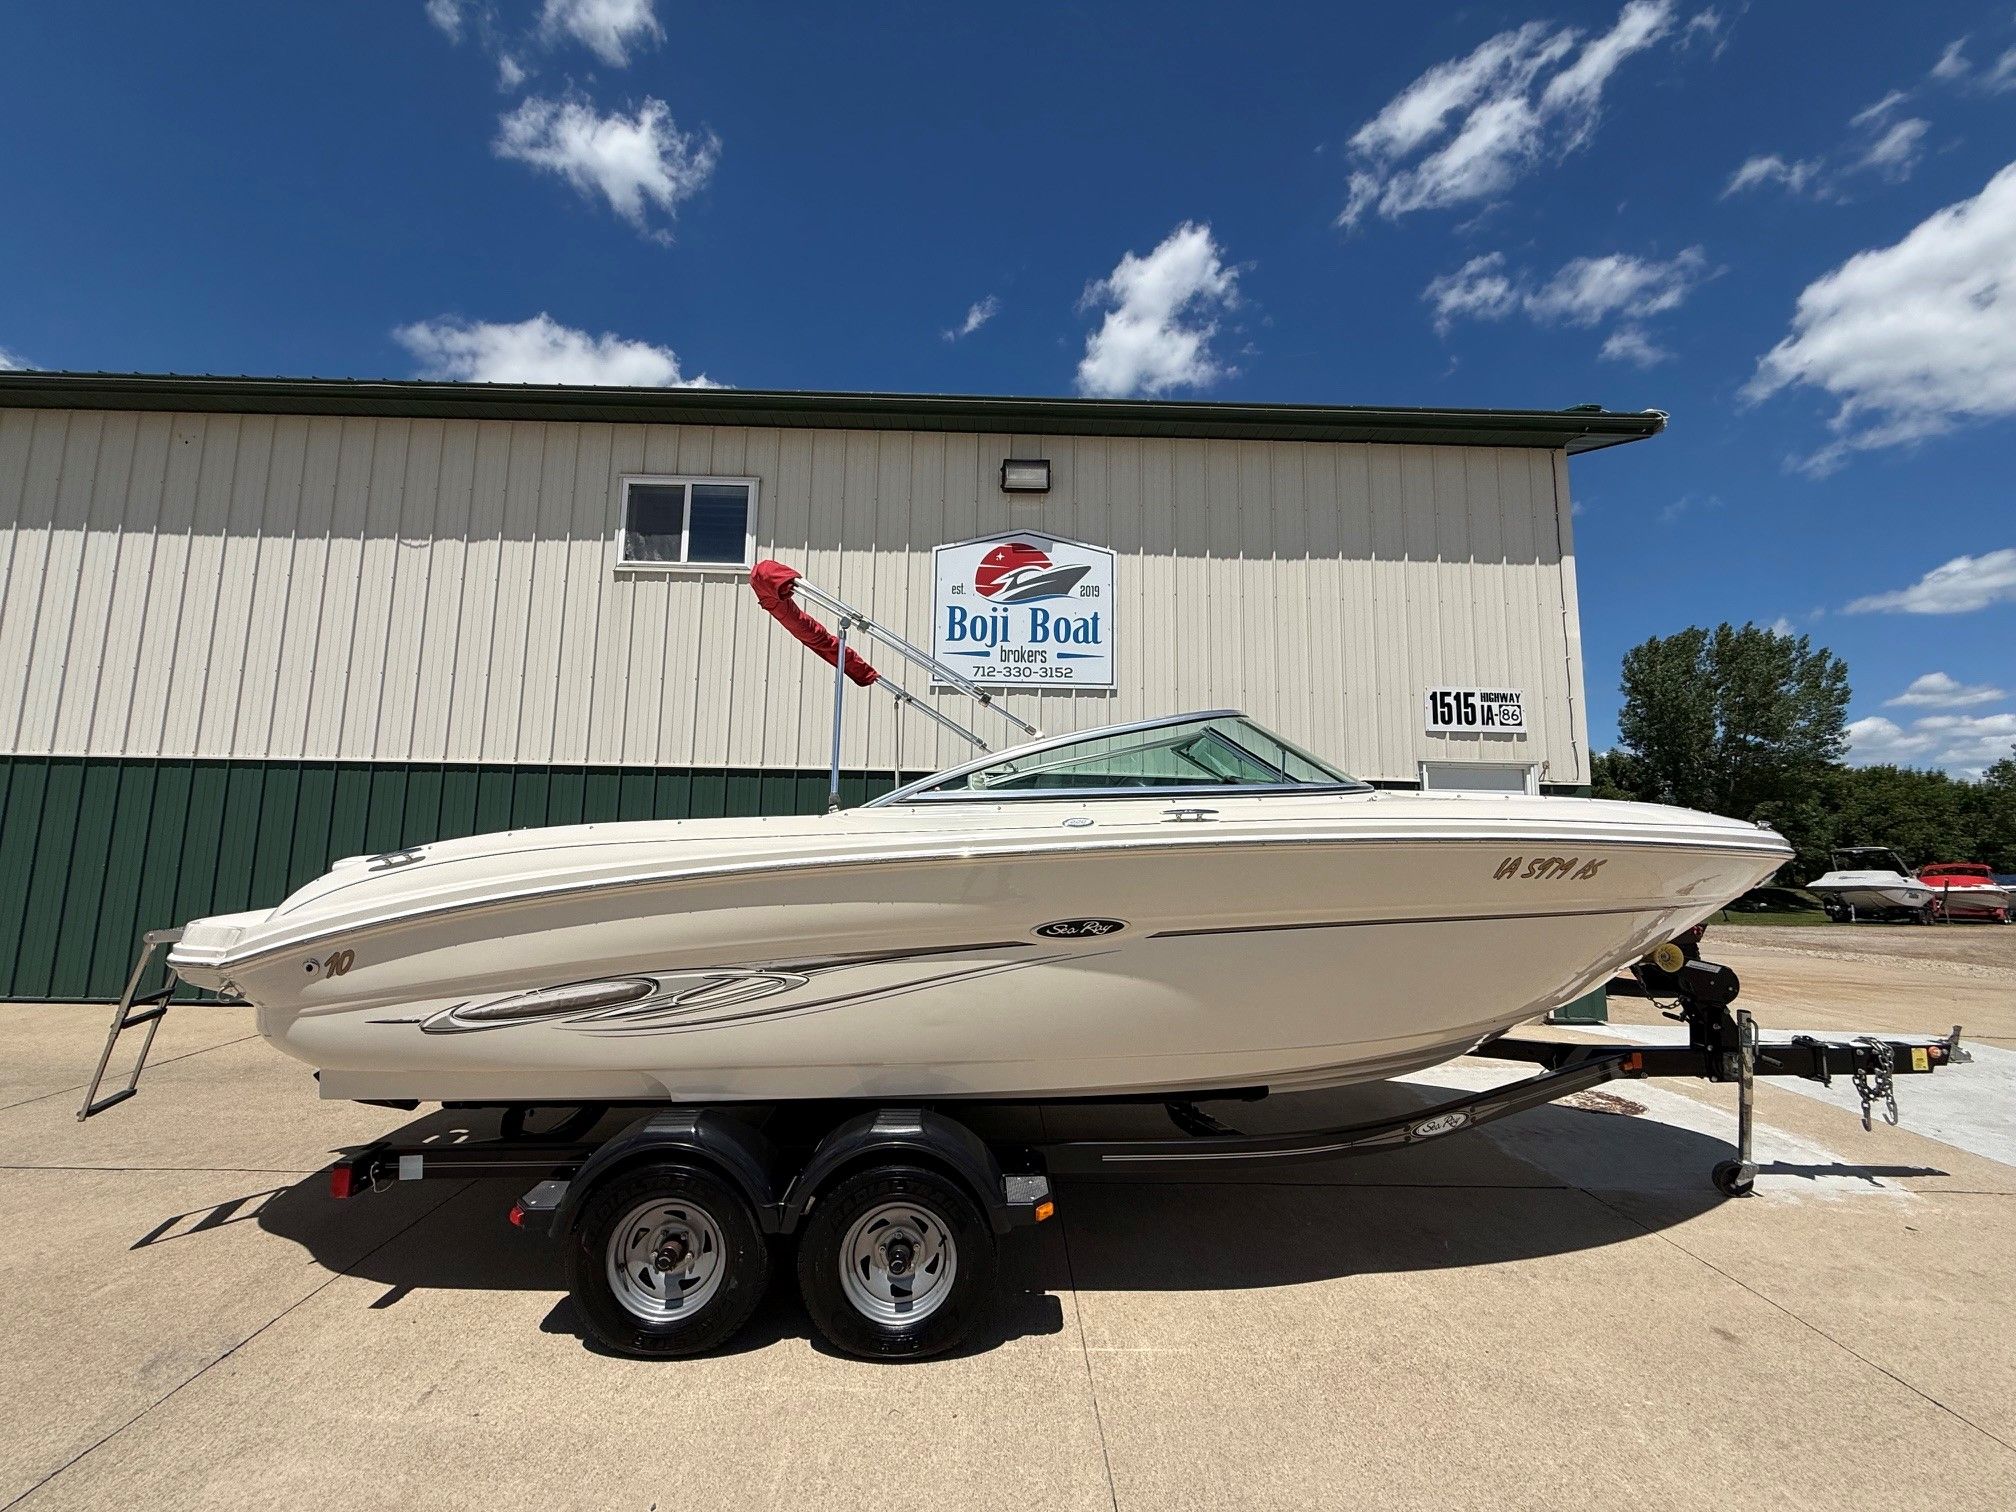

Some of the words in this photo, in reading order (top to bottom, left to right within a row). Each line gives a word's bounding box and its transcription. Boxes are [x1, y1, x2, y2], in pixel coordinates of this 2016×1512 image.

[951, 583, 967, 595] est.
[1080, 585, 1100, 598] 2019
[945, 605, 1011, 648] Boji
[1028, 607, 1102, 645] Boat
[1000, 645, 1047, 664] brokers
[972, 666, 1074, 679] 712-330-3152
[1480, 692, 1521, 703] HIGHWAY
[1429, 691, 1477, 725] 1515
[1570, 858, 1608, 880] AS
[1046, 924, 1079, 935] Sea
[1080, 921, 1113, 935] Ray
[324, 949, 355, 979] 10
[1422, 1121, 1440, 1133] Sea
[1442, 1115, 1461, 1128] Ray
